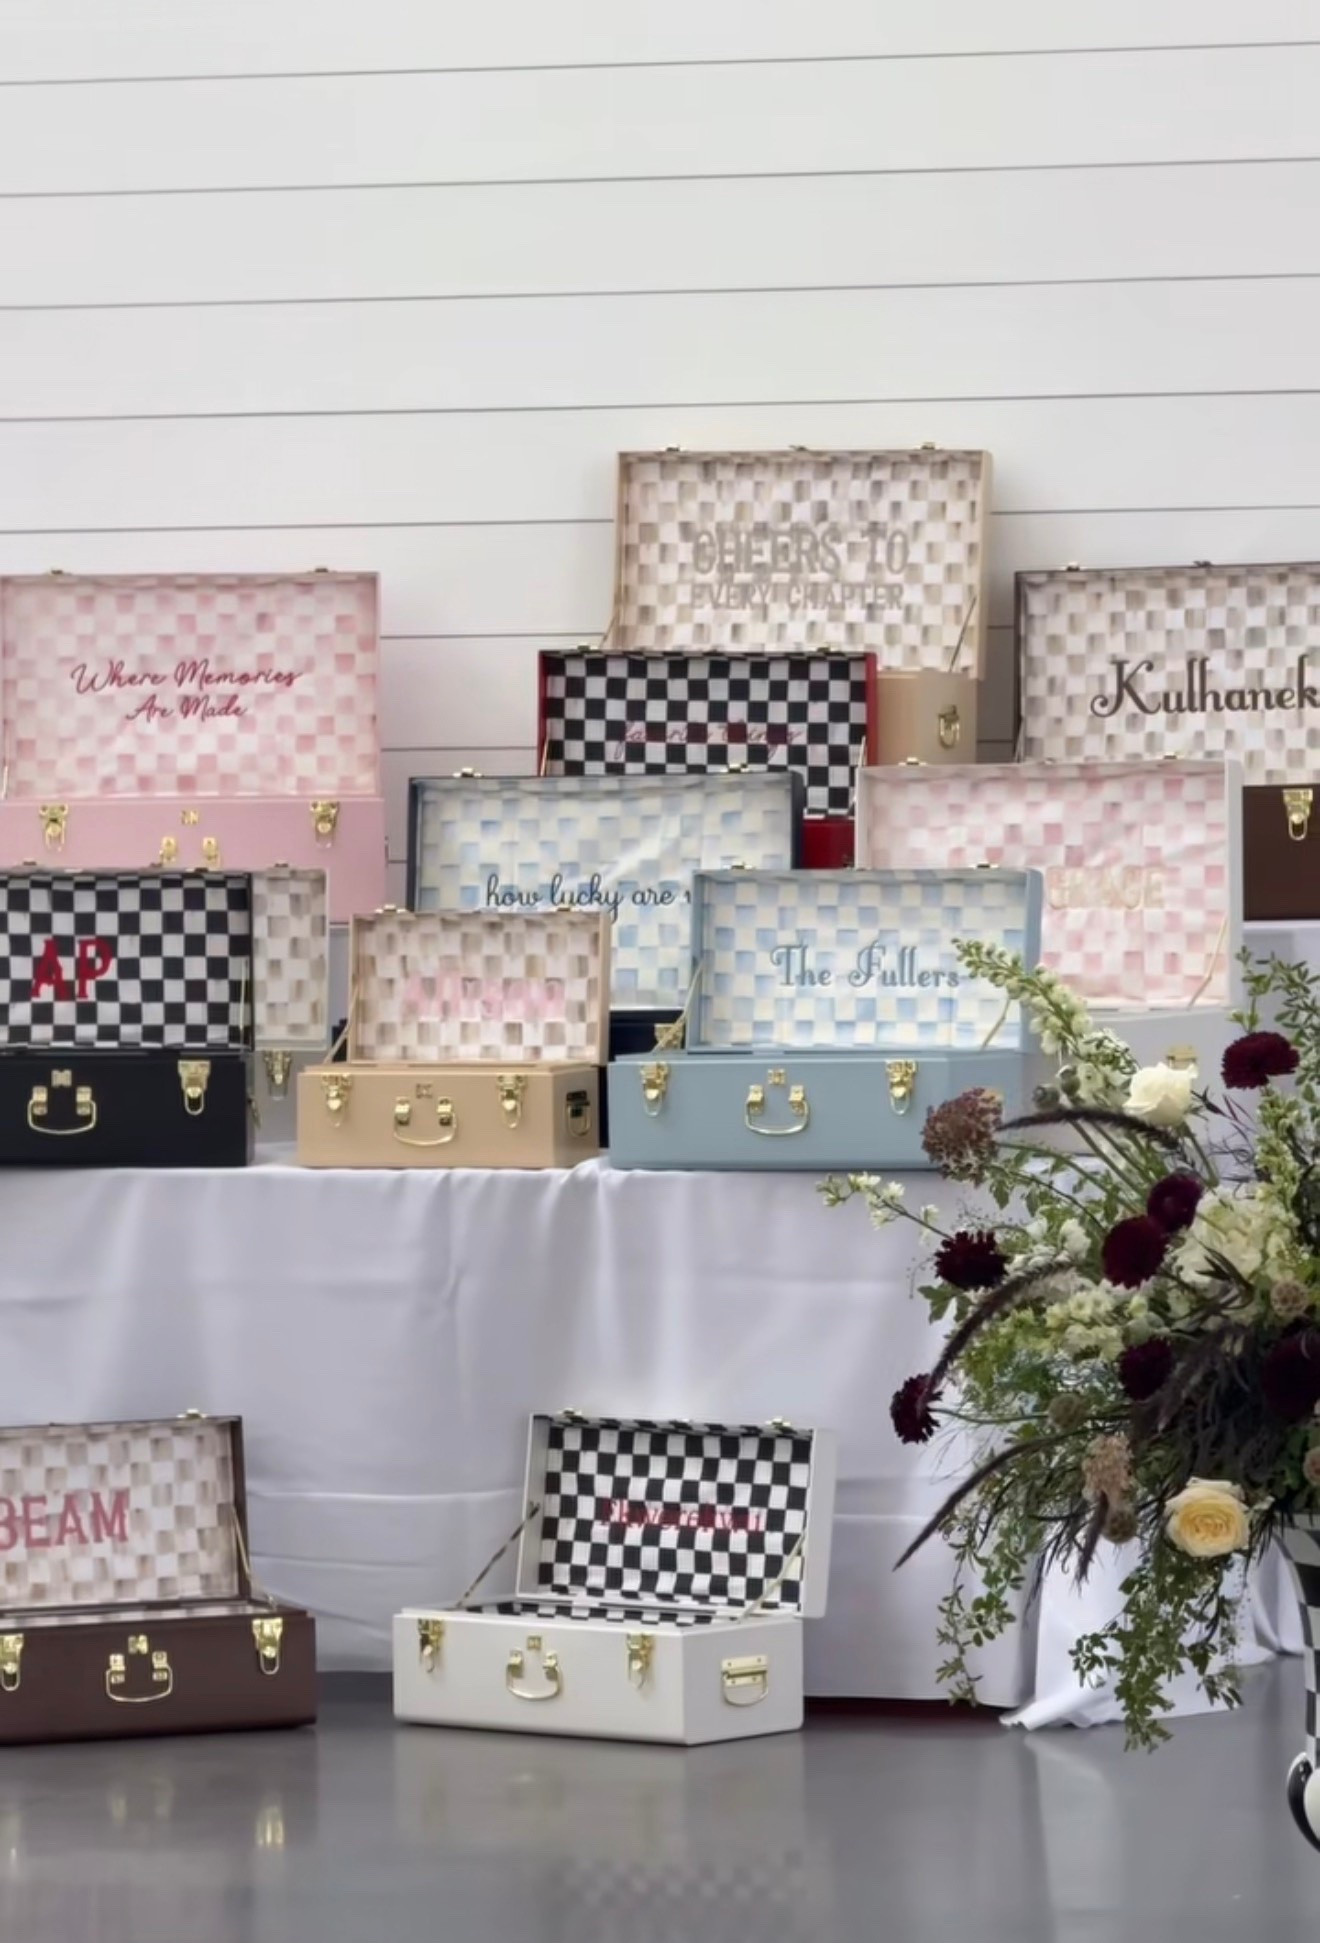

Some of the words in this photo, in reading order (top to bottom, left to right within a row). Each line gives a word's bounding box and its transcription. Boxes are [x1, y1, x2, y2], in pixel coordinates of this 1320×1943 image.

[692, 522, 843, 576] CHEERS
[861, 523, 910, 575] TO
[691, 582, 770, 610] EVERY
[787, 582, 904, 611] CHAPTER
[70, 658, 167, 694] Where
[174, 658, 303, 691] Memories
[1090, 653, 1320, 718] Kulhanek
[125, 694, 173, 723] Are
[179, 694, 247, 723] Made
[486, 873, 544, 907] how
[550, 873, 625, 923] lucky
[631, 887, 677, 907] are
[31, 936, 113, 1002] AP
[770, 939, 832, 987] The
[849, 939, 960, 988] Fullers
[0, 1487, 131, 1551] BEAM
